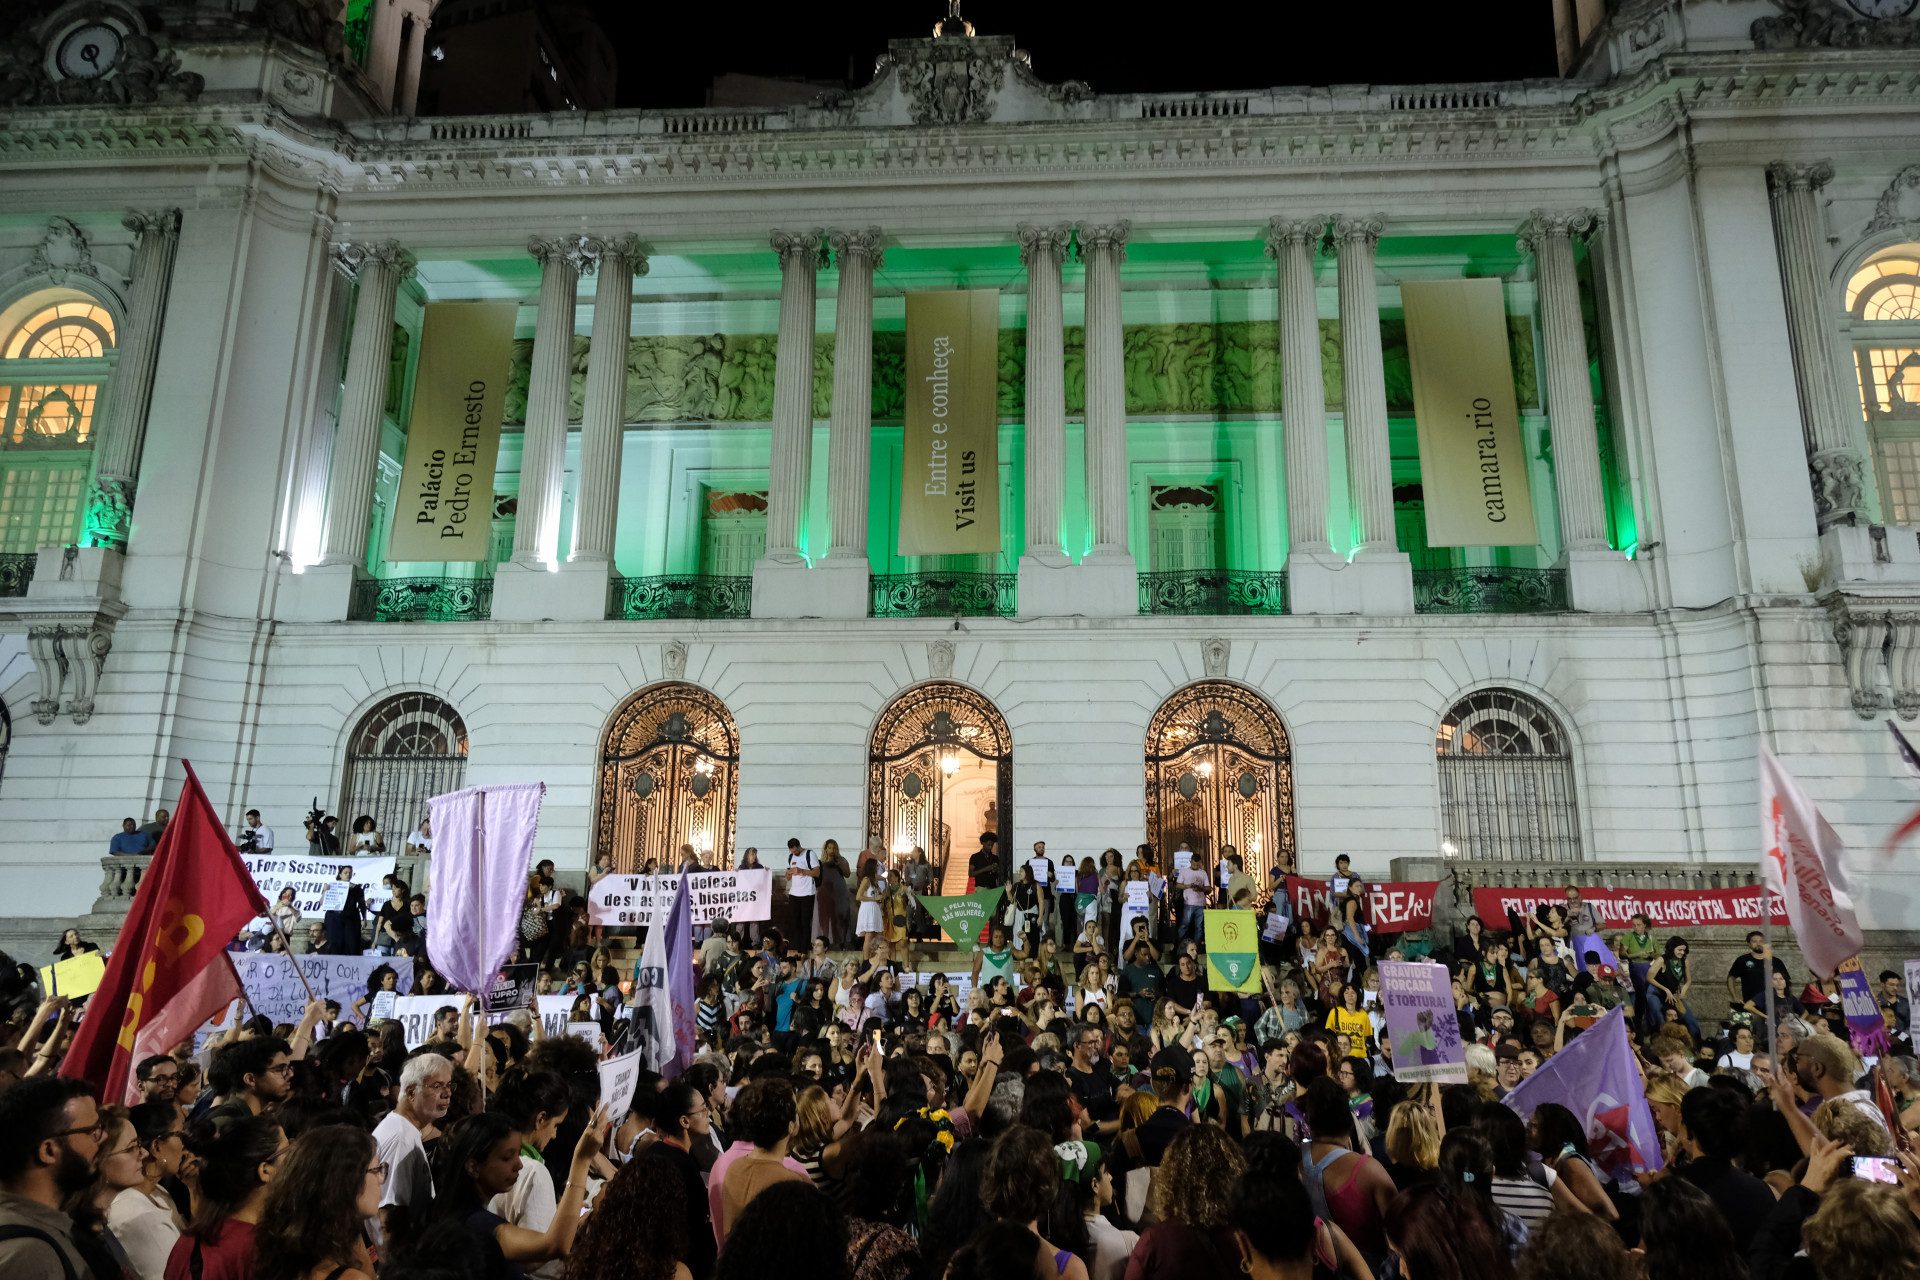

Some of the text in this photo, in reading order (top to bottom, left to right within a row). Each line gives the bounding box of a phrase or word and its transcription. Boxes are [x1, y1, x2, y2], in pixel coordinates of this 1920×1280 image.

[925, 336, 955, 497] Entre e conheça
[441, 380, 486, 539] Pedro Ernesto
[1466, 397, 1506, 523] camara.rio
[417, 449, 446, 525] Palácio
[955, 450, 976, 531] Visit us
[691, 875, 737, 890] defesa
[303, 900, 321, 912] ao
[604, 893, 621, 907] de
[699, 889, 757, 905] bisnetas
[949, 901, 966, 911] PELA
[967, 901, 982, 909] VIDA
[618, 910, 627, 923] e
[942, 909, 986, 922] DAS MULHERES
[264, 965, 275, 979] O
[280, 960, 300, 980] PL
[336, 963, 361, 981] COM
[1383, 965, 1433, 979] GRAVIDEZ
[268, 985, 284, 1001] DA
[490, 988, 519, 1000] TUPRO
[1385, 978, 1434, 994] FORÇADA
[1387, 991, 1447, 1009] É TORTURA!
[544, 1008, 570, 1038] MÃ
